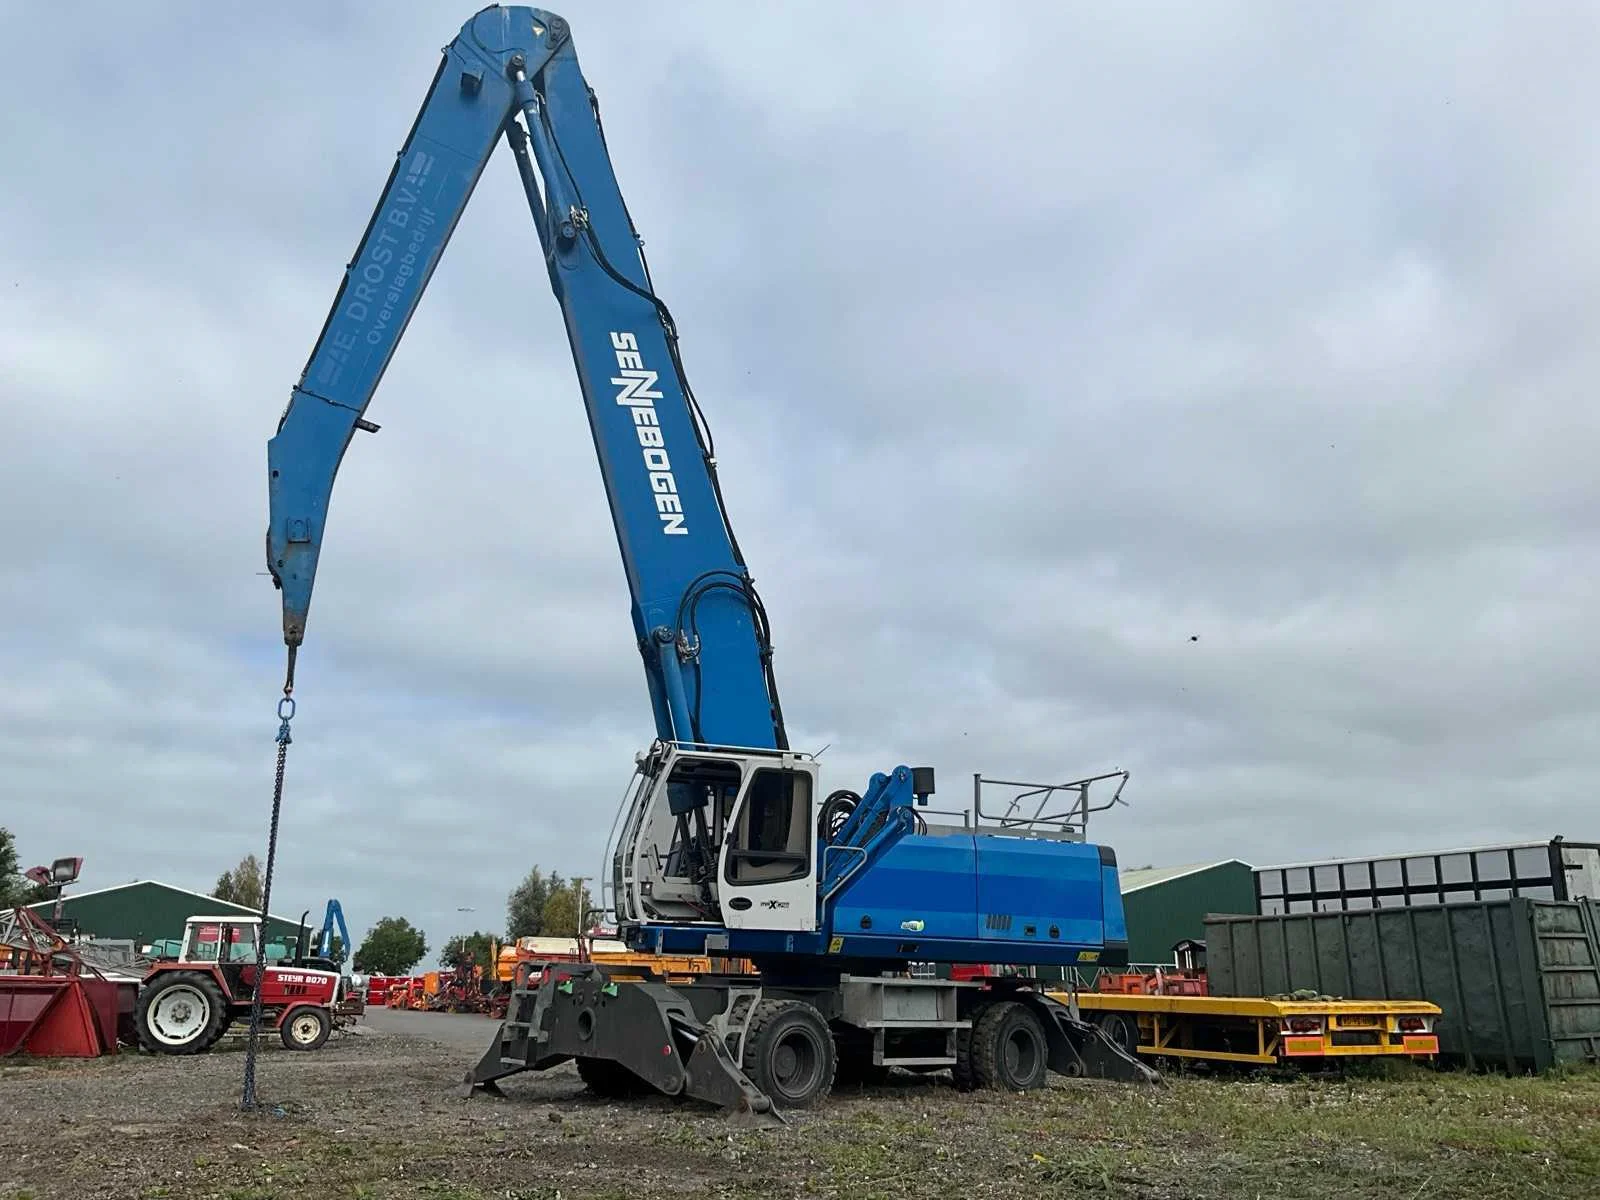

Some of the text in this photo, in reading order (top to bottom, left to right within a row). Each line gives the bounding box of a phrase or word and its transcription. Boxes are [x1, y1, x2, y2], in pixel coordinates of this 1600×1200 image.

[346, 229, 399, 322] DROST
[391, 187, 421, 227] B.V.
[367, 208, 436, 345] Overslagbedrijf
[610, 331, 689, 535] SENNEBOGEN
[277, 974, 328, 985] STEYR 8070
